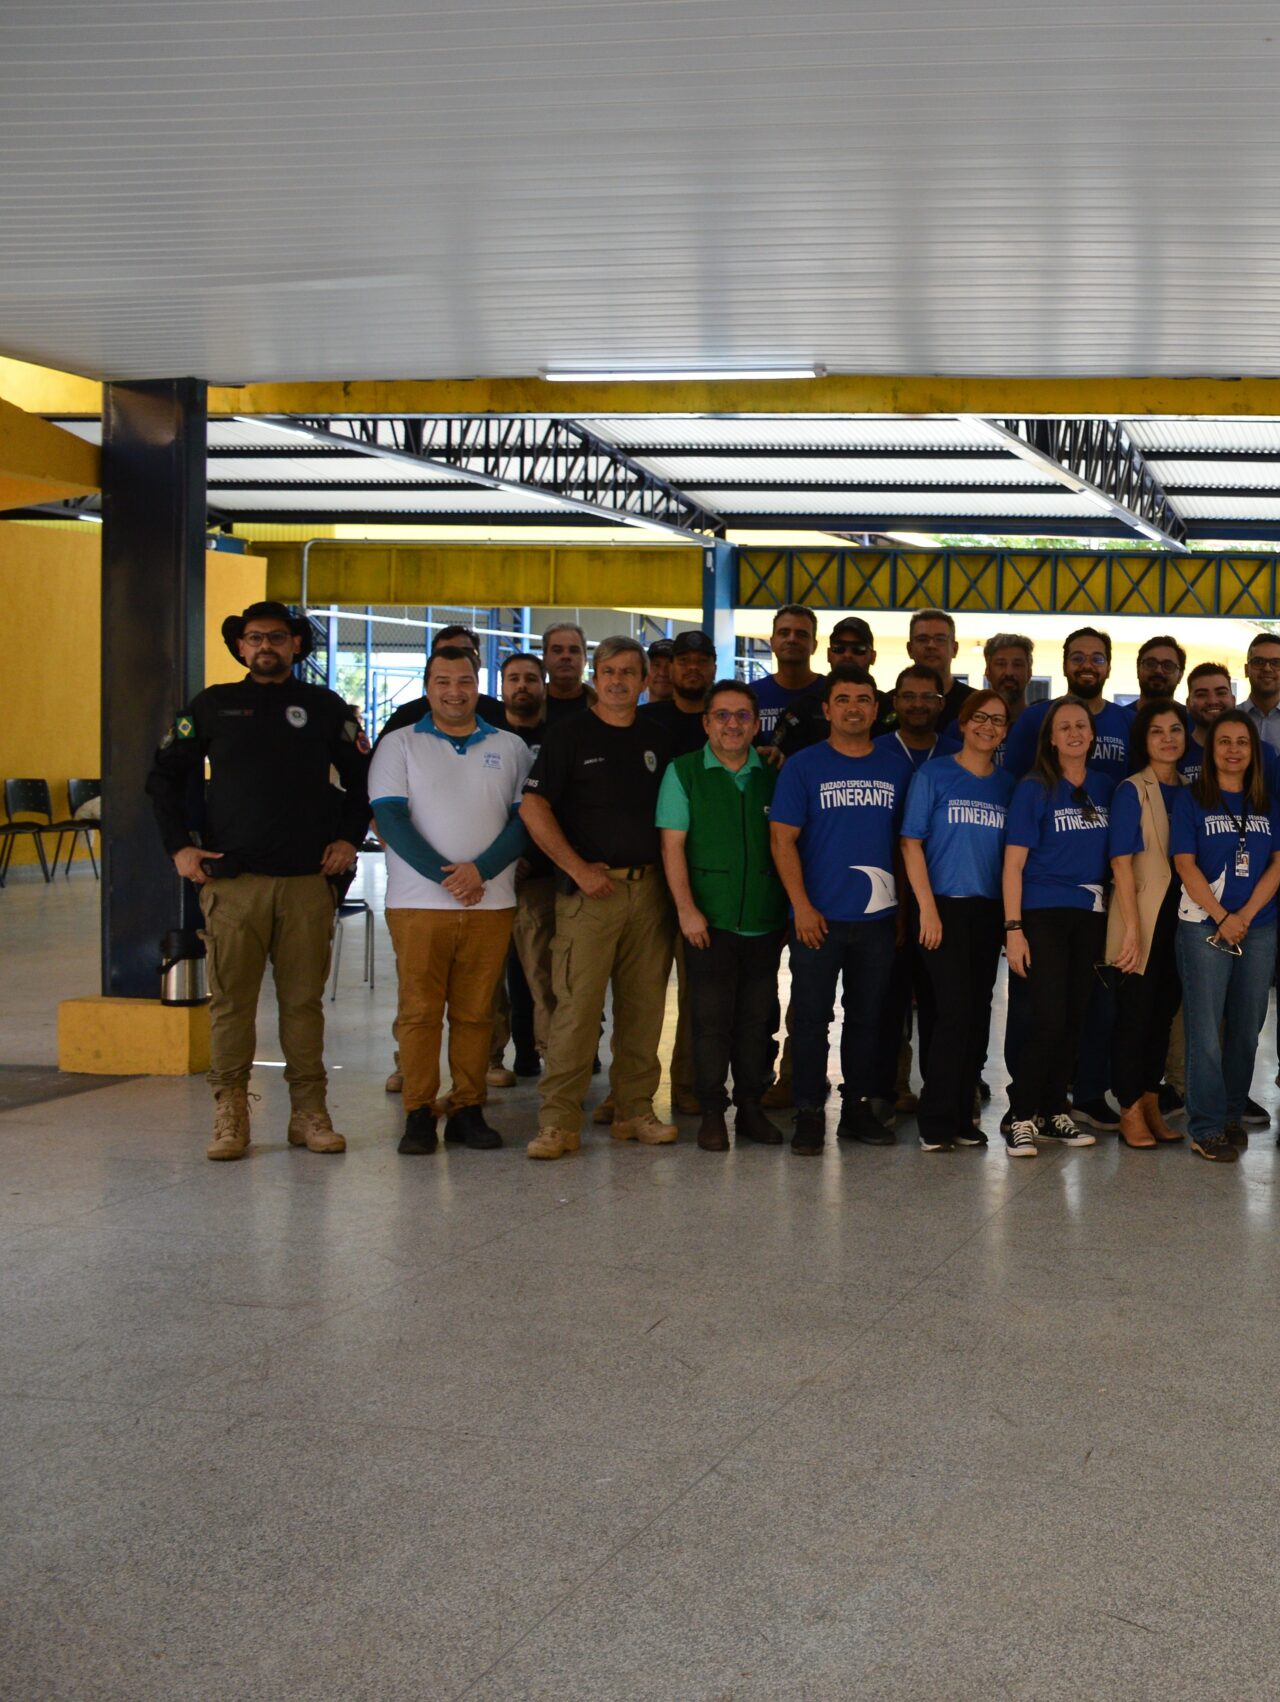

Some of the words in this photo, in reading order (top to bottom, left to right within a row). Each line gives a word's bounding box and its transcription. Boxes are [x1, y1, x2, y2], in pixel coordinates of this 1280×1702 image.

[820, 783, 845, 791] JUIZADO
[847, 780, 872, 788] ESPECIAL
[873, 781, 895, 792] FEDERAL
[820, 789, 895, 810] ITINERANTE
